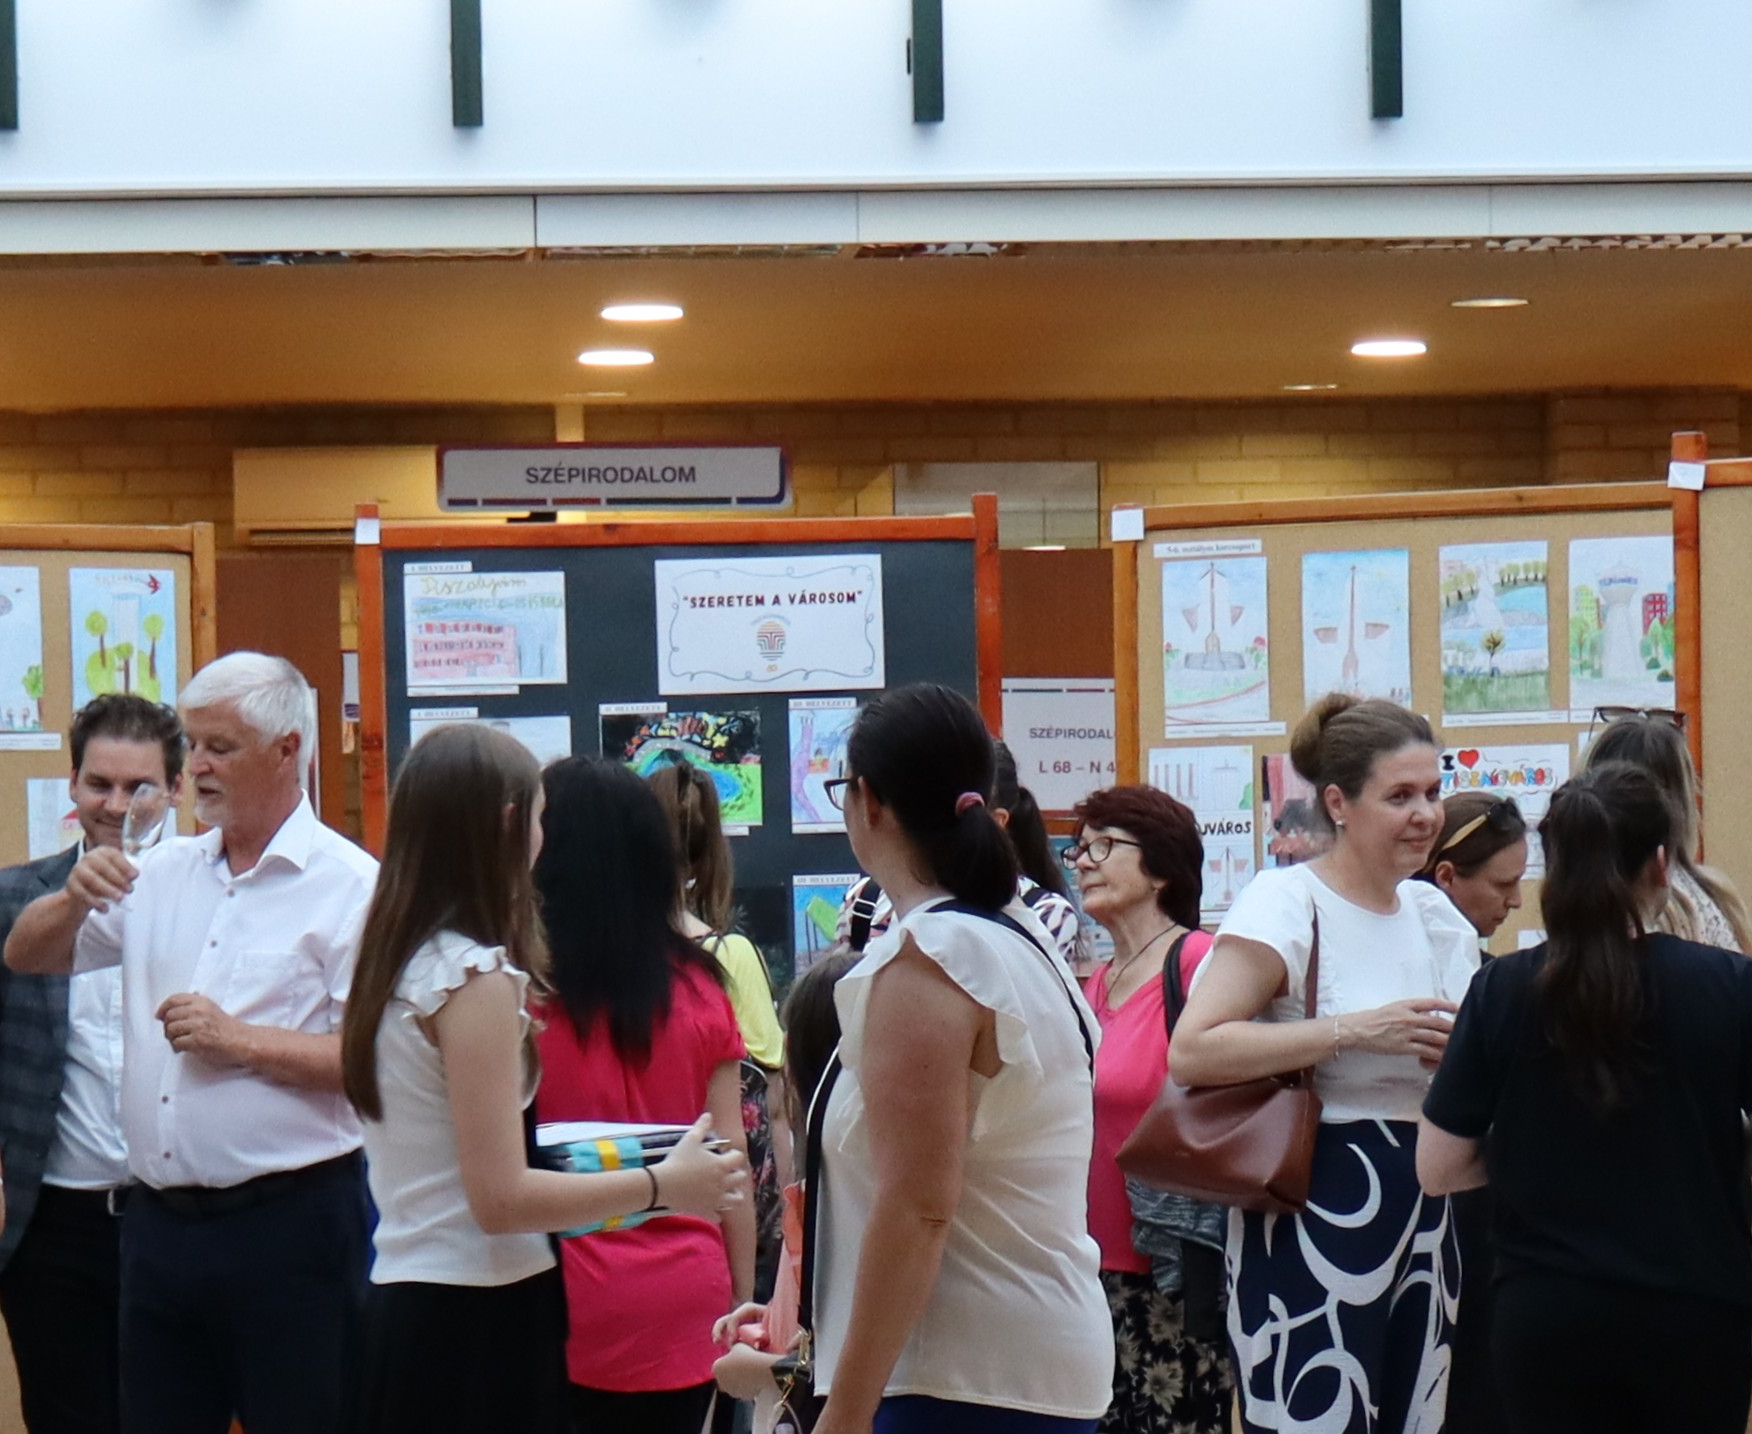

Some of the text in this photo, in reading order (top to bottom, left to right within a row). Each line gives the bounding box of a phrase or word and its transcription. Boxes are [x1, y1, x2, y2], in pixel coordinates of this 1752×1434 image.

[525, 463, 697, 484] SZÉPIRODALOM
[771, 594, 782, 606] A
[788, 589, 863, 606] VÁROSOM"
[1029, 725, 1115, 740] SZÉPIRODAL
[1039, 761, 1048, 773] L
[1053, 761, 1072, 774] 68
[1090, 761, 1101, 773] N
[1107, 761, 1116, 773] 4
[1441, 754, 1455, 771] I
